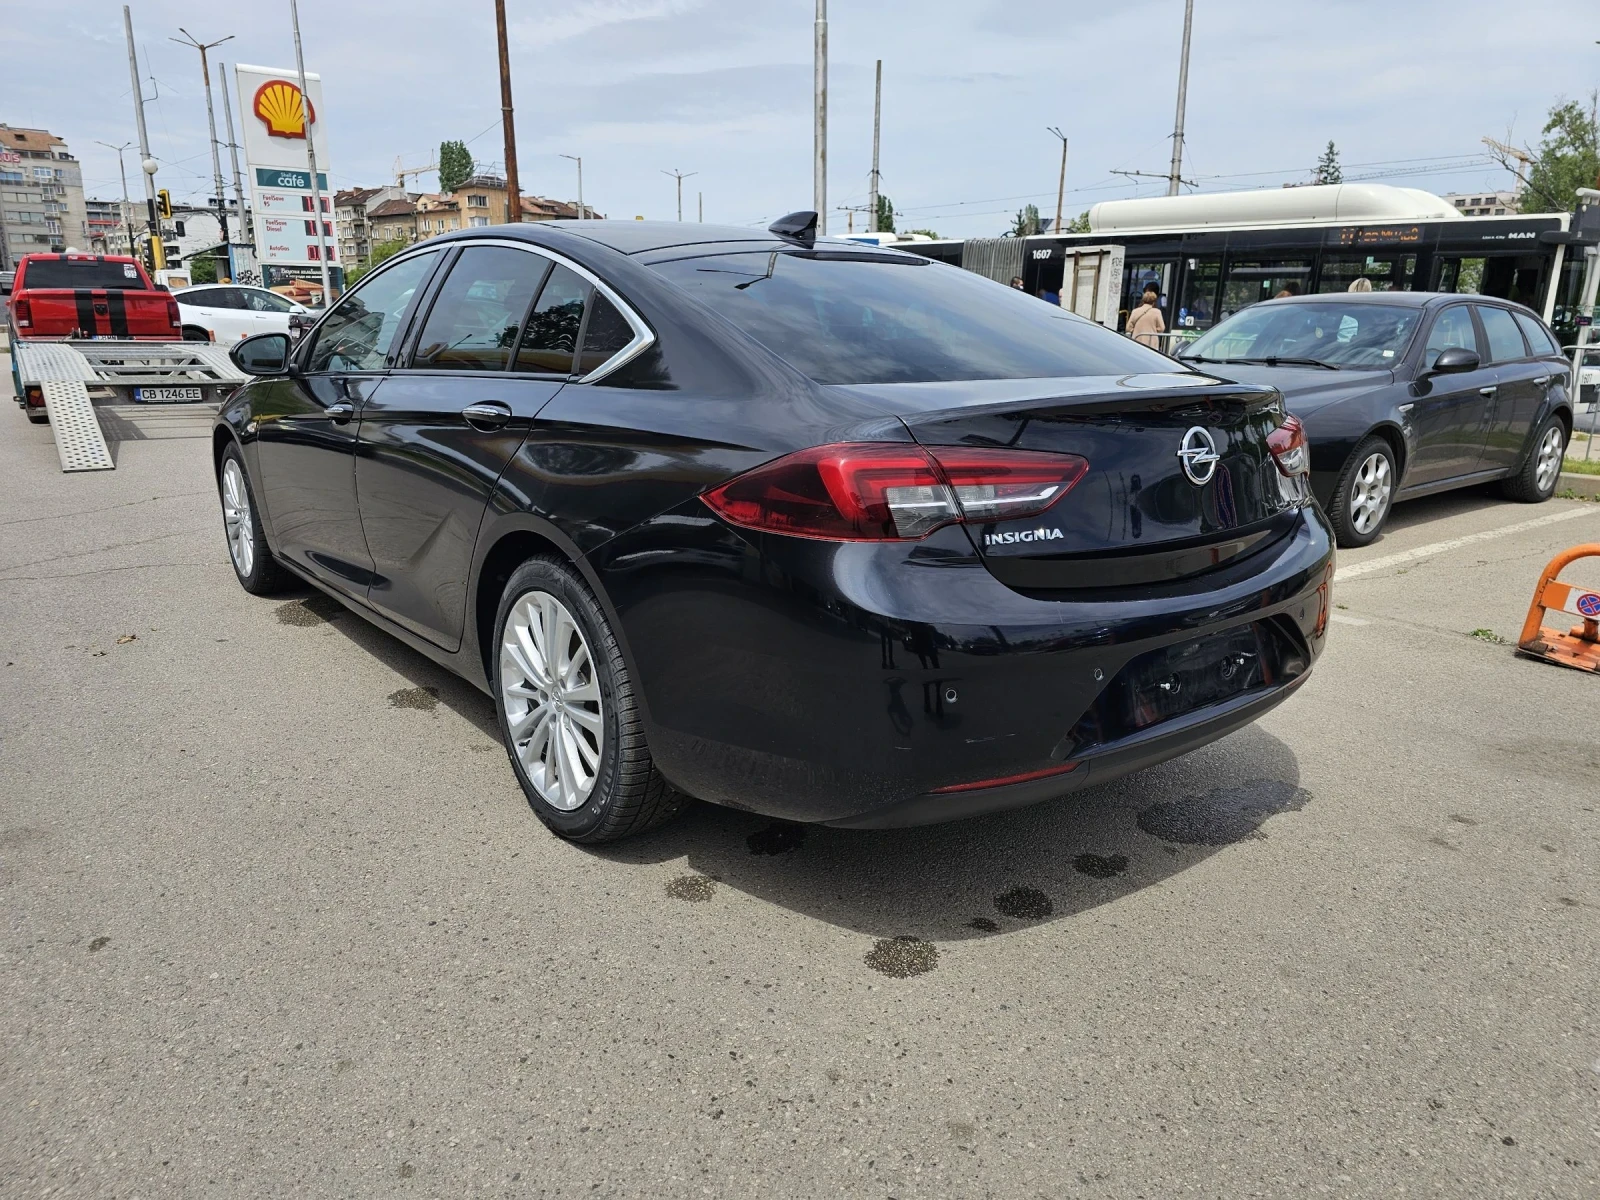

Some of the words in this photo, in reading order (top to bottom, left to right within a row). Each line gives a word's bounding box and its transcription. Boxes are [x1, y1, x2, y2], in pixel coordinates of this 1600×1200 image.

[278, 174, 305, 187] café
[1032, 249, 1052, 259] 1607
[142, 389, 157, 399] CB
[159, 389, 184, 399] 1246
[185, 389, 200, 399] EE
[984, 528, 1064, 545] INSIGNIA
